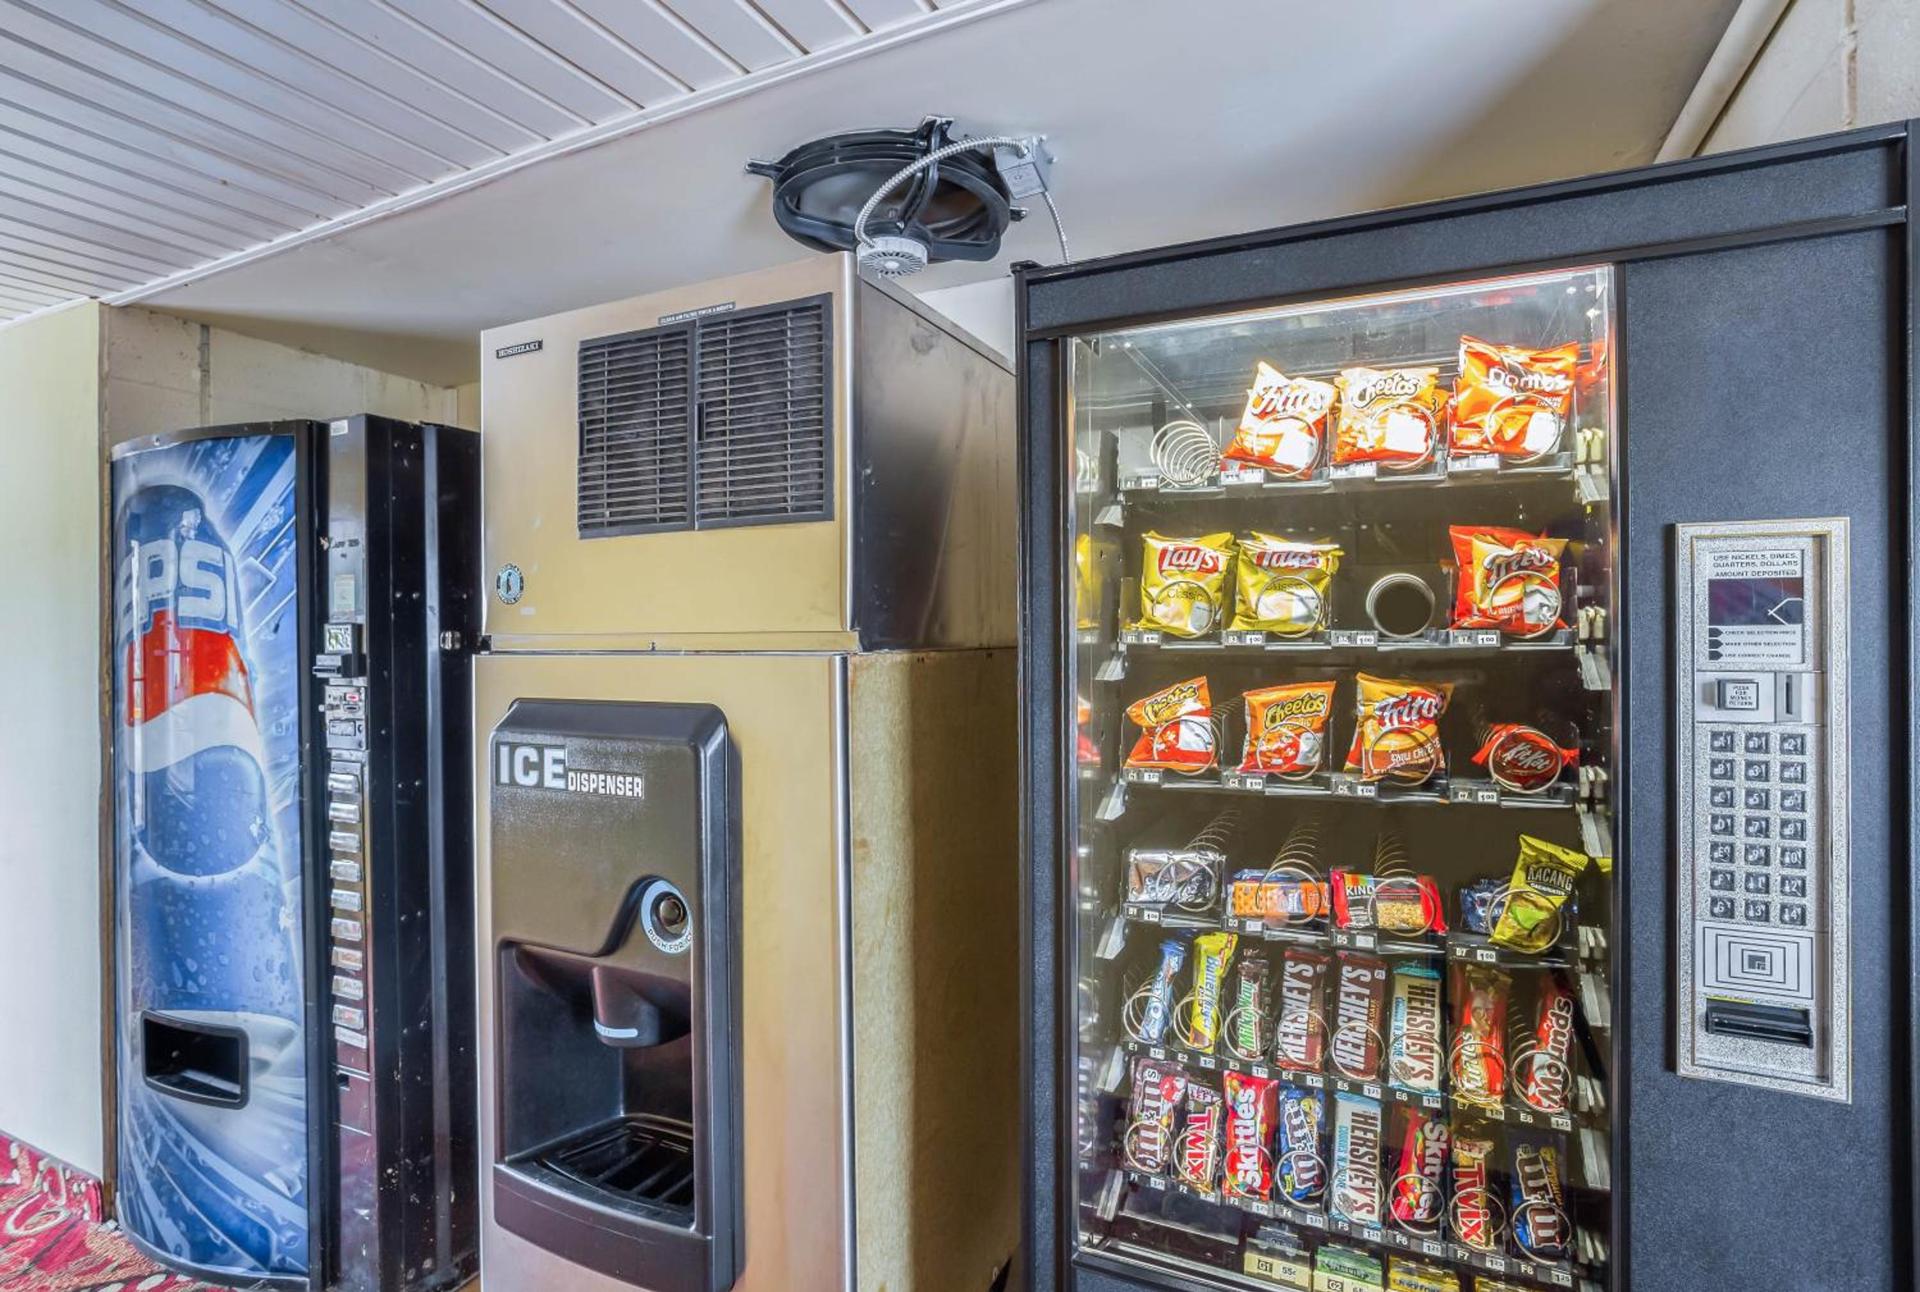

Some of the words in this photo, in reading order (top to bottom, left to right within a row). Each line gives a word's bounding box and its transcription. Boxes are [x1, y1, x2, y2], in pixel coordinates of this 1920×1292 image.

[1352, 372, 1419, 408] Cheetos
[1265, 691, 1327, 729] Cheetos
[499, 745, 566, 789] ICE
[568, 771, 643, 798] DISPENSER
[1346, 885, 1374, 896] KIND
[1335, 965, 1373, 1070] HERSHEY'S
[1405, 985, 1436, 1081] HERSHEY'S
[1537, 997, 1574, 1108] Mounds
[1233, 1088, 1262, 1188] Skittles
[1348, 1111, 1379, 1215] HERSHEY'S
[1328, 1280, 1341, 1291] G2
